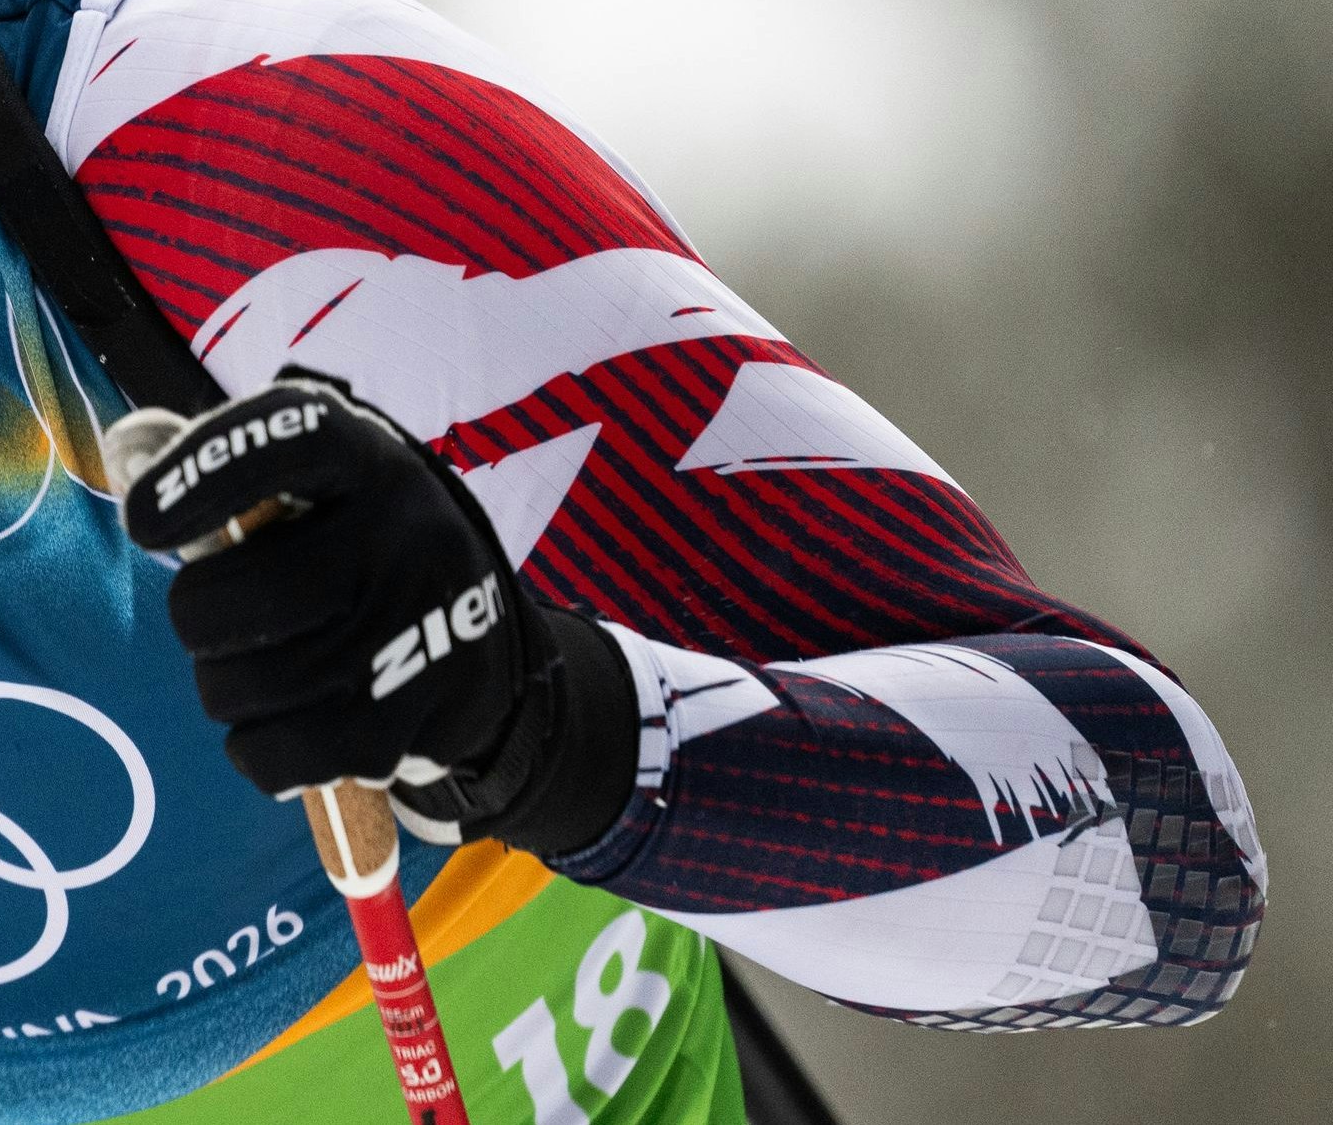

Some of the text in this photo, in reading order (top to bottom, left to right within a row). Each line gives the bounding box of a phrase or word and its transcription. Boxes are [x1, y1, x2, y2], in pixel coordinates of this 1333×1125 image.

[155, 402, 329, 513] ziener
[156, 903, 304, 1001] 2026
[492, 908, 671, 1125] 18
